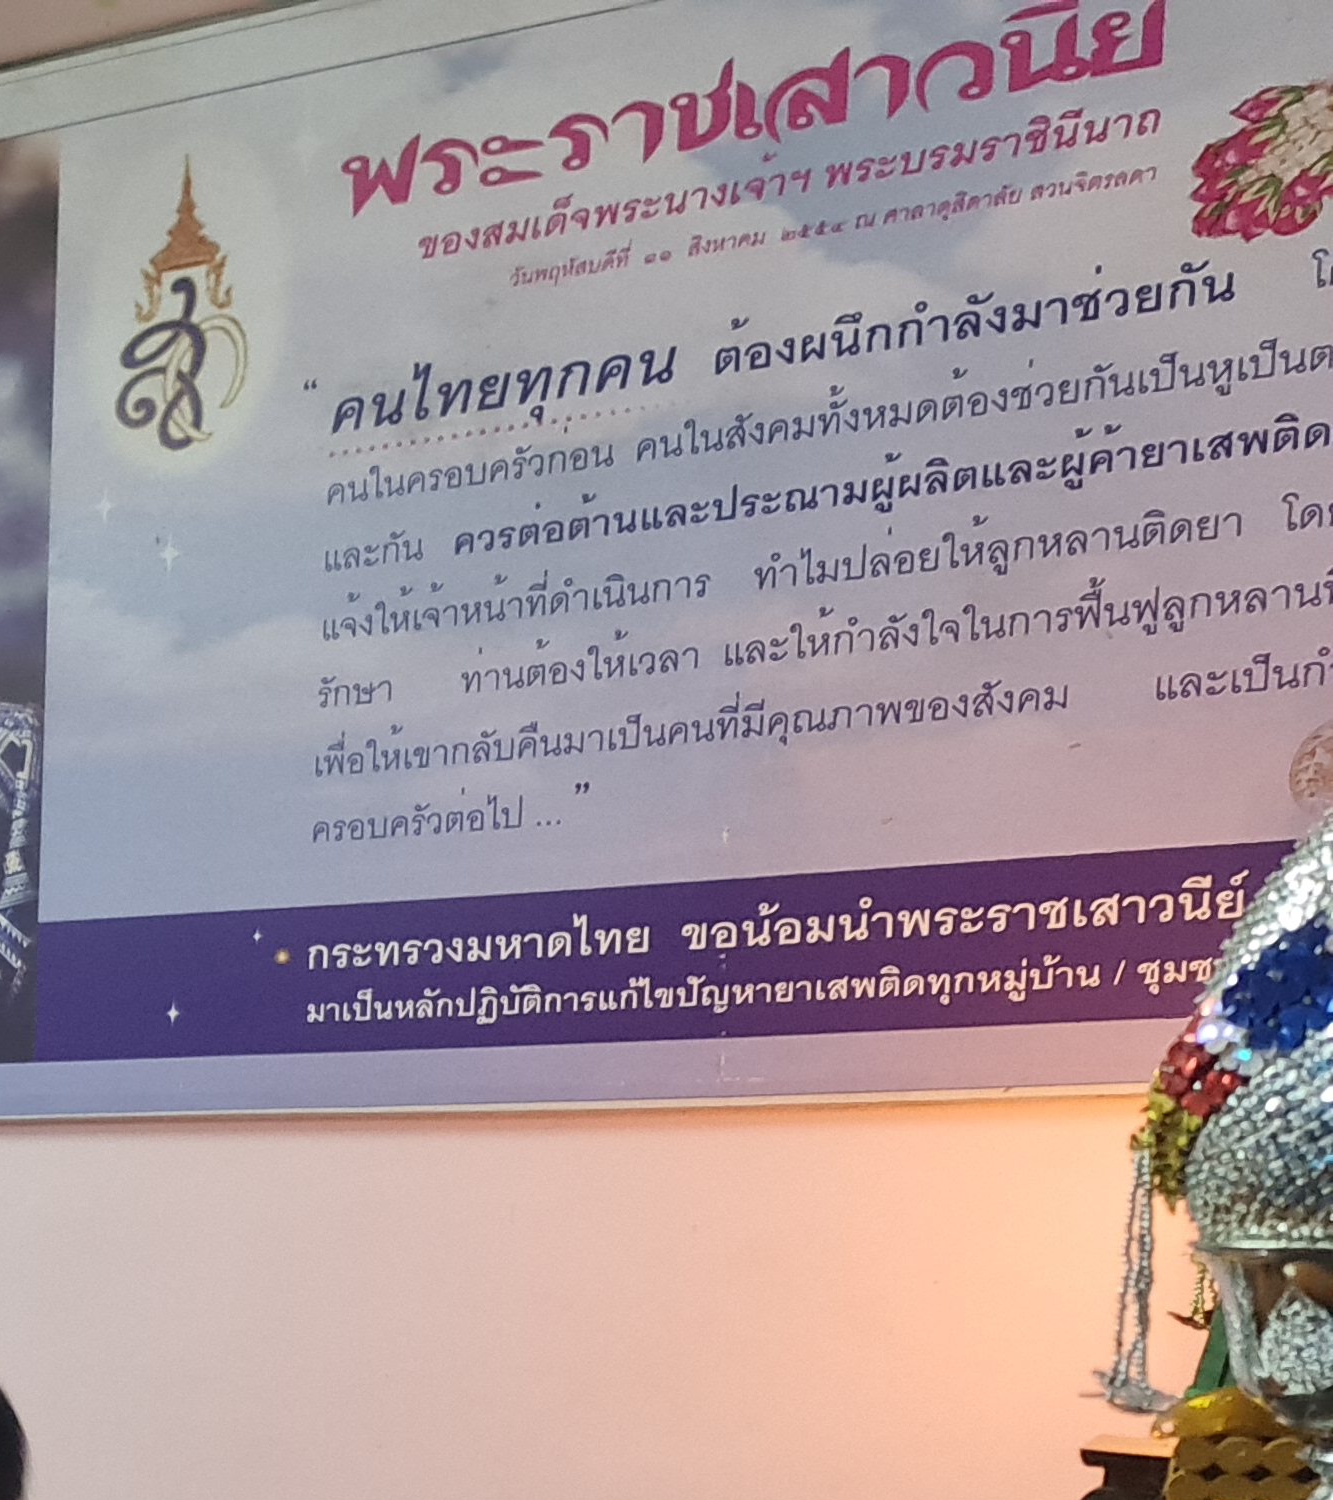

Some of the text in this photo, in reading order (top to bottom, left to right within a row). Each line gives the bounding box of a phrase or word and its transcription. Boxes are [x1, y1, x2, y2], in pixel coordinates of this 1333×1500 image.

[825, 107, 1162, 187] พระบรมราชินีนาถ
[688, 231, 766, 257] สิงหาคม
[855, 212, 876, 230] ณ
[713, 259, 1236, 376] ต้องผนึกกำลังมาช่วยกัน
[324, 412, 1331, 573] และกัน ควรต่อต้านและประณามผู้ผลิตและผู้ค้ายาเสพติด
[326, 425, 615, 506] คนในครอบครัวก่อน
[322, 492, 1333, 642] แจ้งให้เจ้าหน้าที่ดำเนินการ ทำไมปล่อยให้ลูกหลานติดยา โด
[318, 675, 393, 708] รักษา
[461, 629, 699, 694] ท่านต้องให้เวลา
[314, 680, 1069, 778] เพื่อให้เขากลับคืนมาเป็นคนที่มีคุณภาพของสังคม
[313, 786, 523, 844] ครอบครัวต่อไป
[307, 869, 1250, 970] กระทรวงมหาดไทย ขอน้อมนำพระราชเสาวนีย์
[306, 954, 1101, 1025] มาเป็นหลักปฏิบัติการแก้ไขปัญหายาเสพติดทุกหมู่บ้าน
